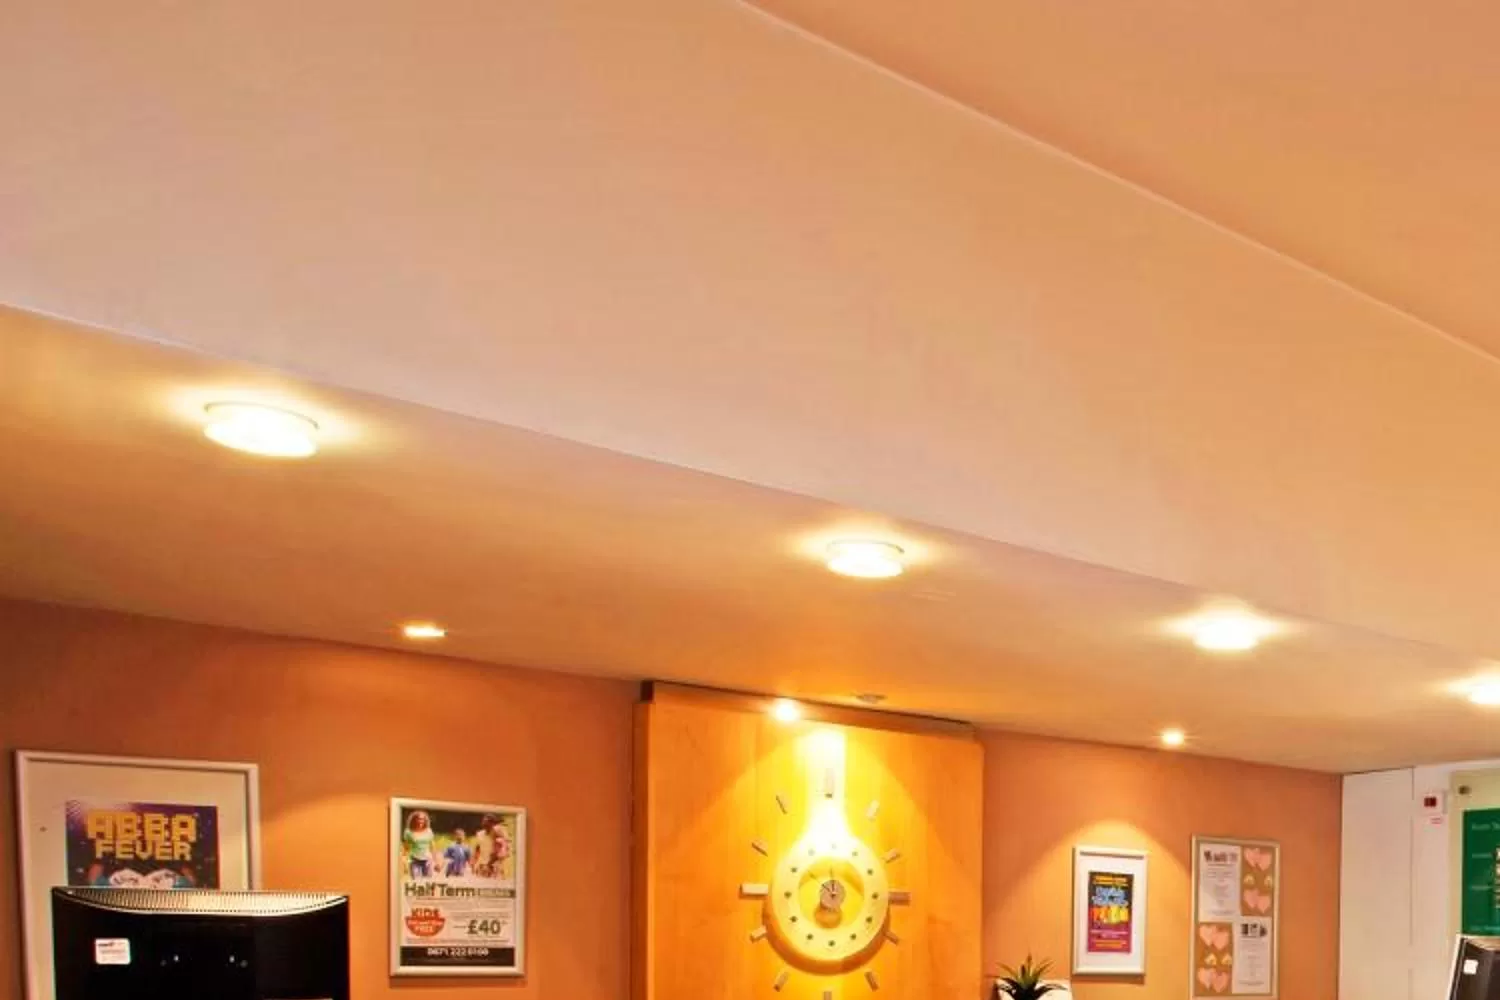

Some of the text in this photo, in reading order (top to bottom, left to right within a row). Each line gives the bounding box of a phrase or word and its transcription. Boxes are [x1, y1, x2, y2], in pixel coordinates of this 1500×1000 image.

[87, 810, 197, 842] ABBA
[95, 839, 192, 861] FEVER
[404, 882, 436, 897] Half
[437, 883, 475, 897] Term
[467, 919, 501, 935] £40
